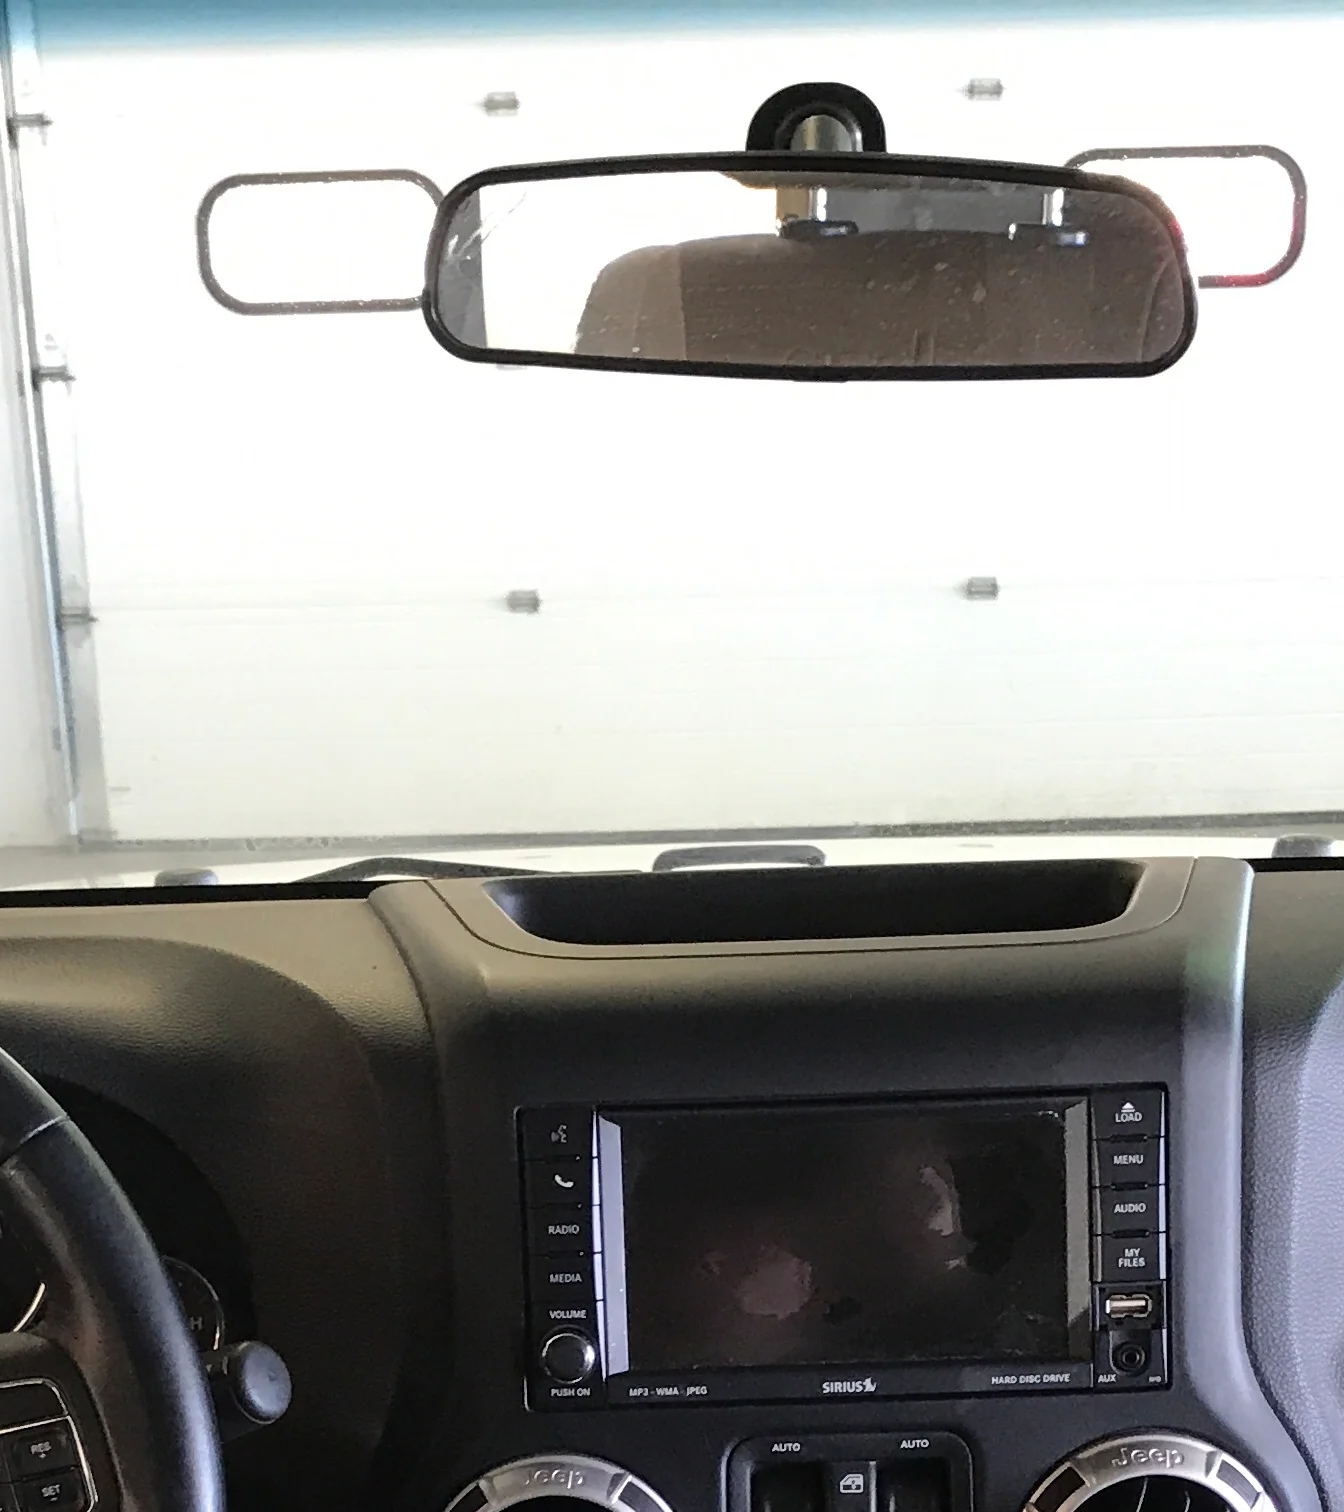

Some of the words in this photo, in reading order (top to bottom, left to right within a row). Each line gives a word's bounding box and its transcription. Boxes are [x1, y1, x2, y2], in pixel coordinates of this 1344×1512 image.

[1115, 1111, 1142, 1123] LOAD
[1113, 1154, 1144, 1165] MENU
[1113, 1202, 1147, 1214] AUDIO
[548, 1225, 580, 1236] RADIO
[1124, 1247, 1142, 1258] MY
[1118, 1257, 1147, 1268] FILES
[549, 1273, 582, 1284] MEDIA
[549, 1309, 587, 1320] VOLUME
[190, 1316, 203, 1331] H
[991, 1374, 1017, 1385] HARD
[1019, 1374, 1041, 1384] DISC
[1043, 1373, 1071, 1384] DRIVE
[1098, 1374, 1117, 1384] AUX
[550, 1387, 573, 1397] PUSH
[575, 1387, 591, 1397] ON
[629, 1387, 650, 1397] MP3
[655, 1387, 680, 1397] WMA
[686, 1386, 708, 1396] JPEG
[822, 1380, 864, 1394] SIRIUS
[771, 1442, 802, 1453] AUTO
[900, 1438, 930, 1450] AUTO
[1111, 1446, 1185, 1469] Jeep
[41, 1483, 62, 1498] SET
